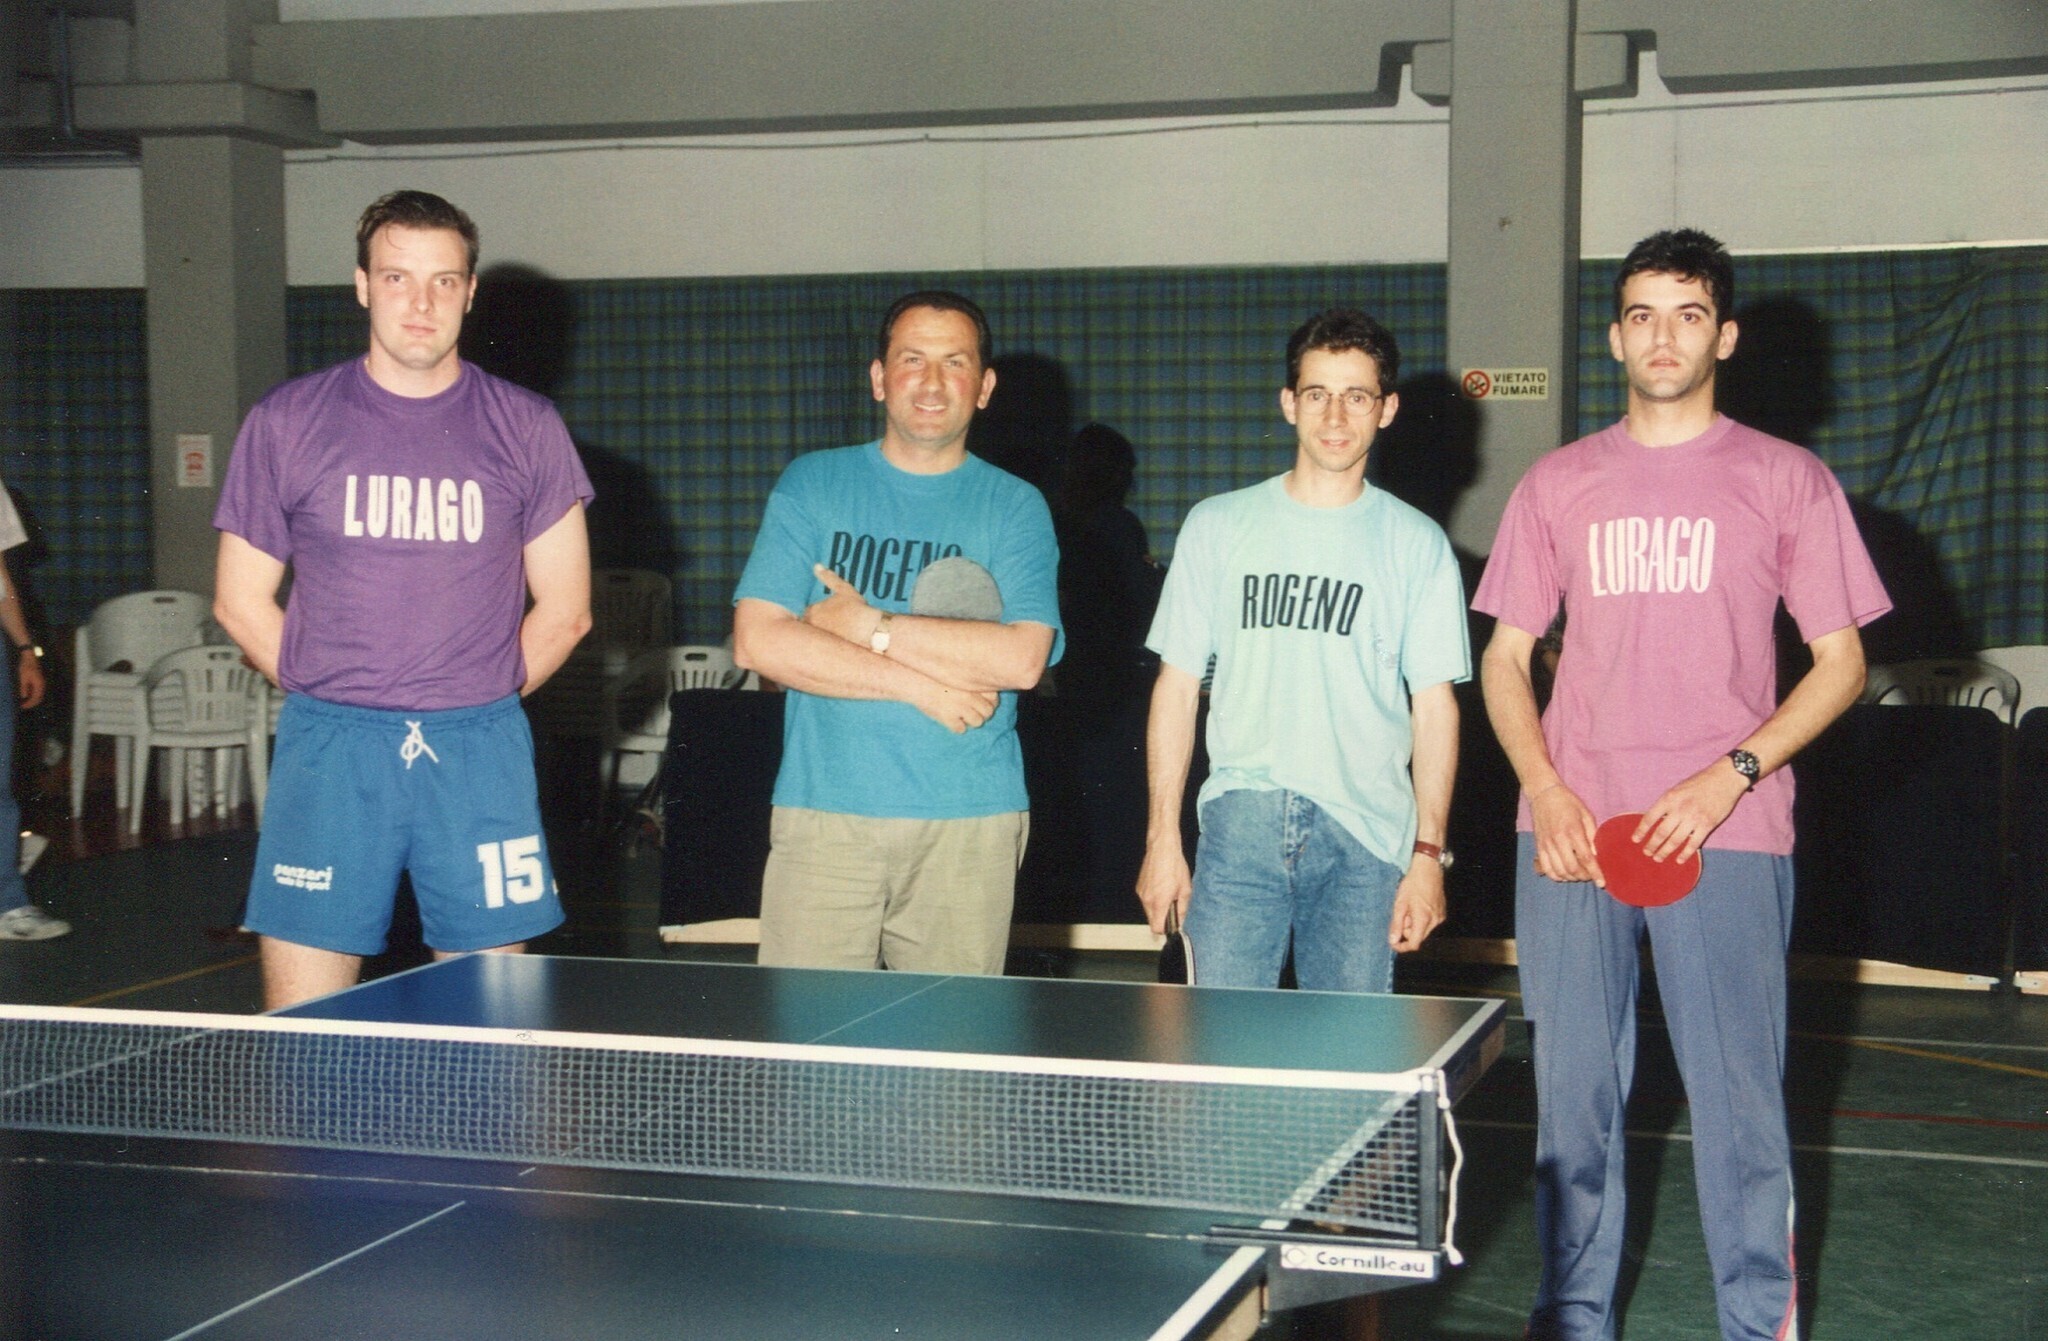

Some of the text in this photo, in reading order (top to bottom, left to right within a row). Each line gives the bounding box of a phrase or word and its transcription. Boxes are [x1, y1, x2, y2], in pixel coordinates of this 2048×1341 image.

[1492, 386, 1546, 395] FUMARE
[1493, 373, 1546, 382] VIETATO
[344, 474, 484, 543] LURAGO
[823, 531, 963, 602] ROGE
[1588, 515, 1716, 597] LURAGO
[1241, 573, 1364, 636] ROGENO
[477, 834, 545, 909] 15
